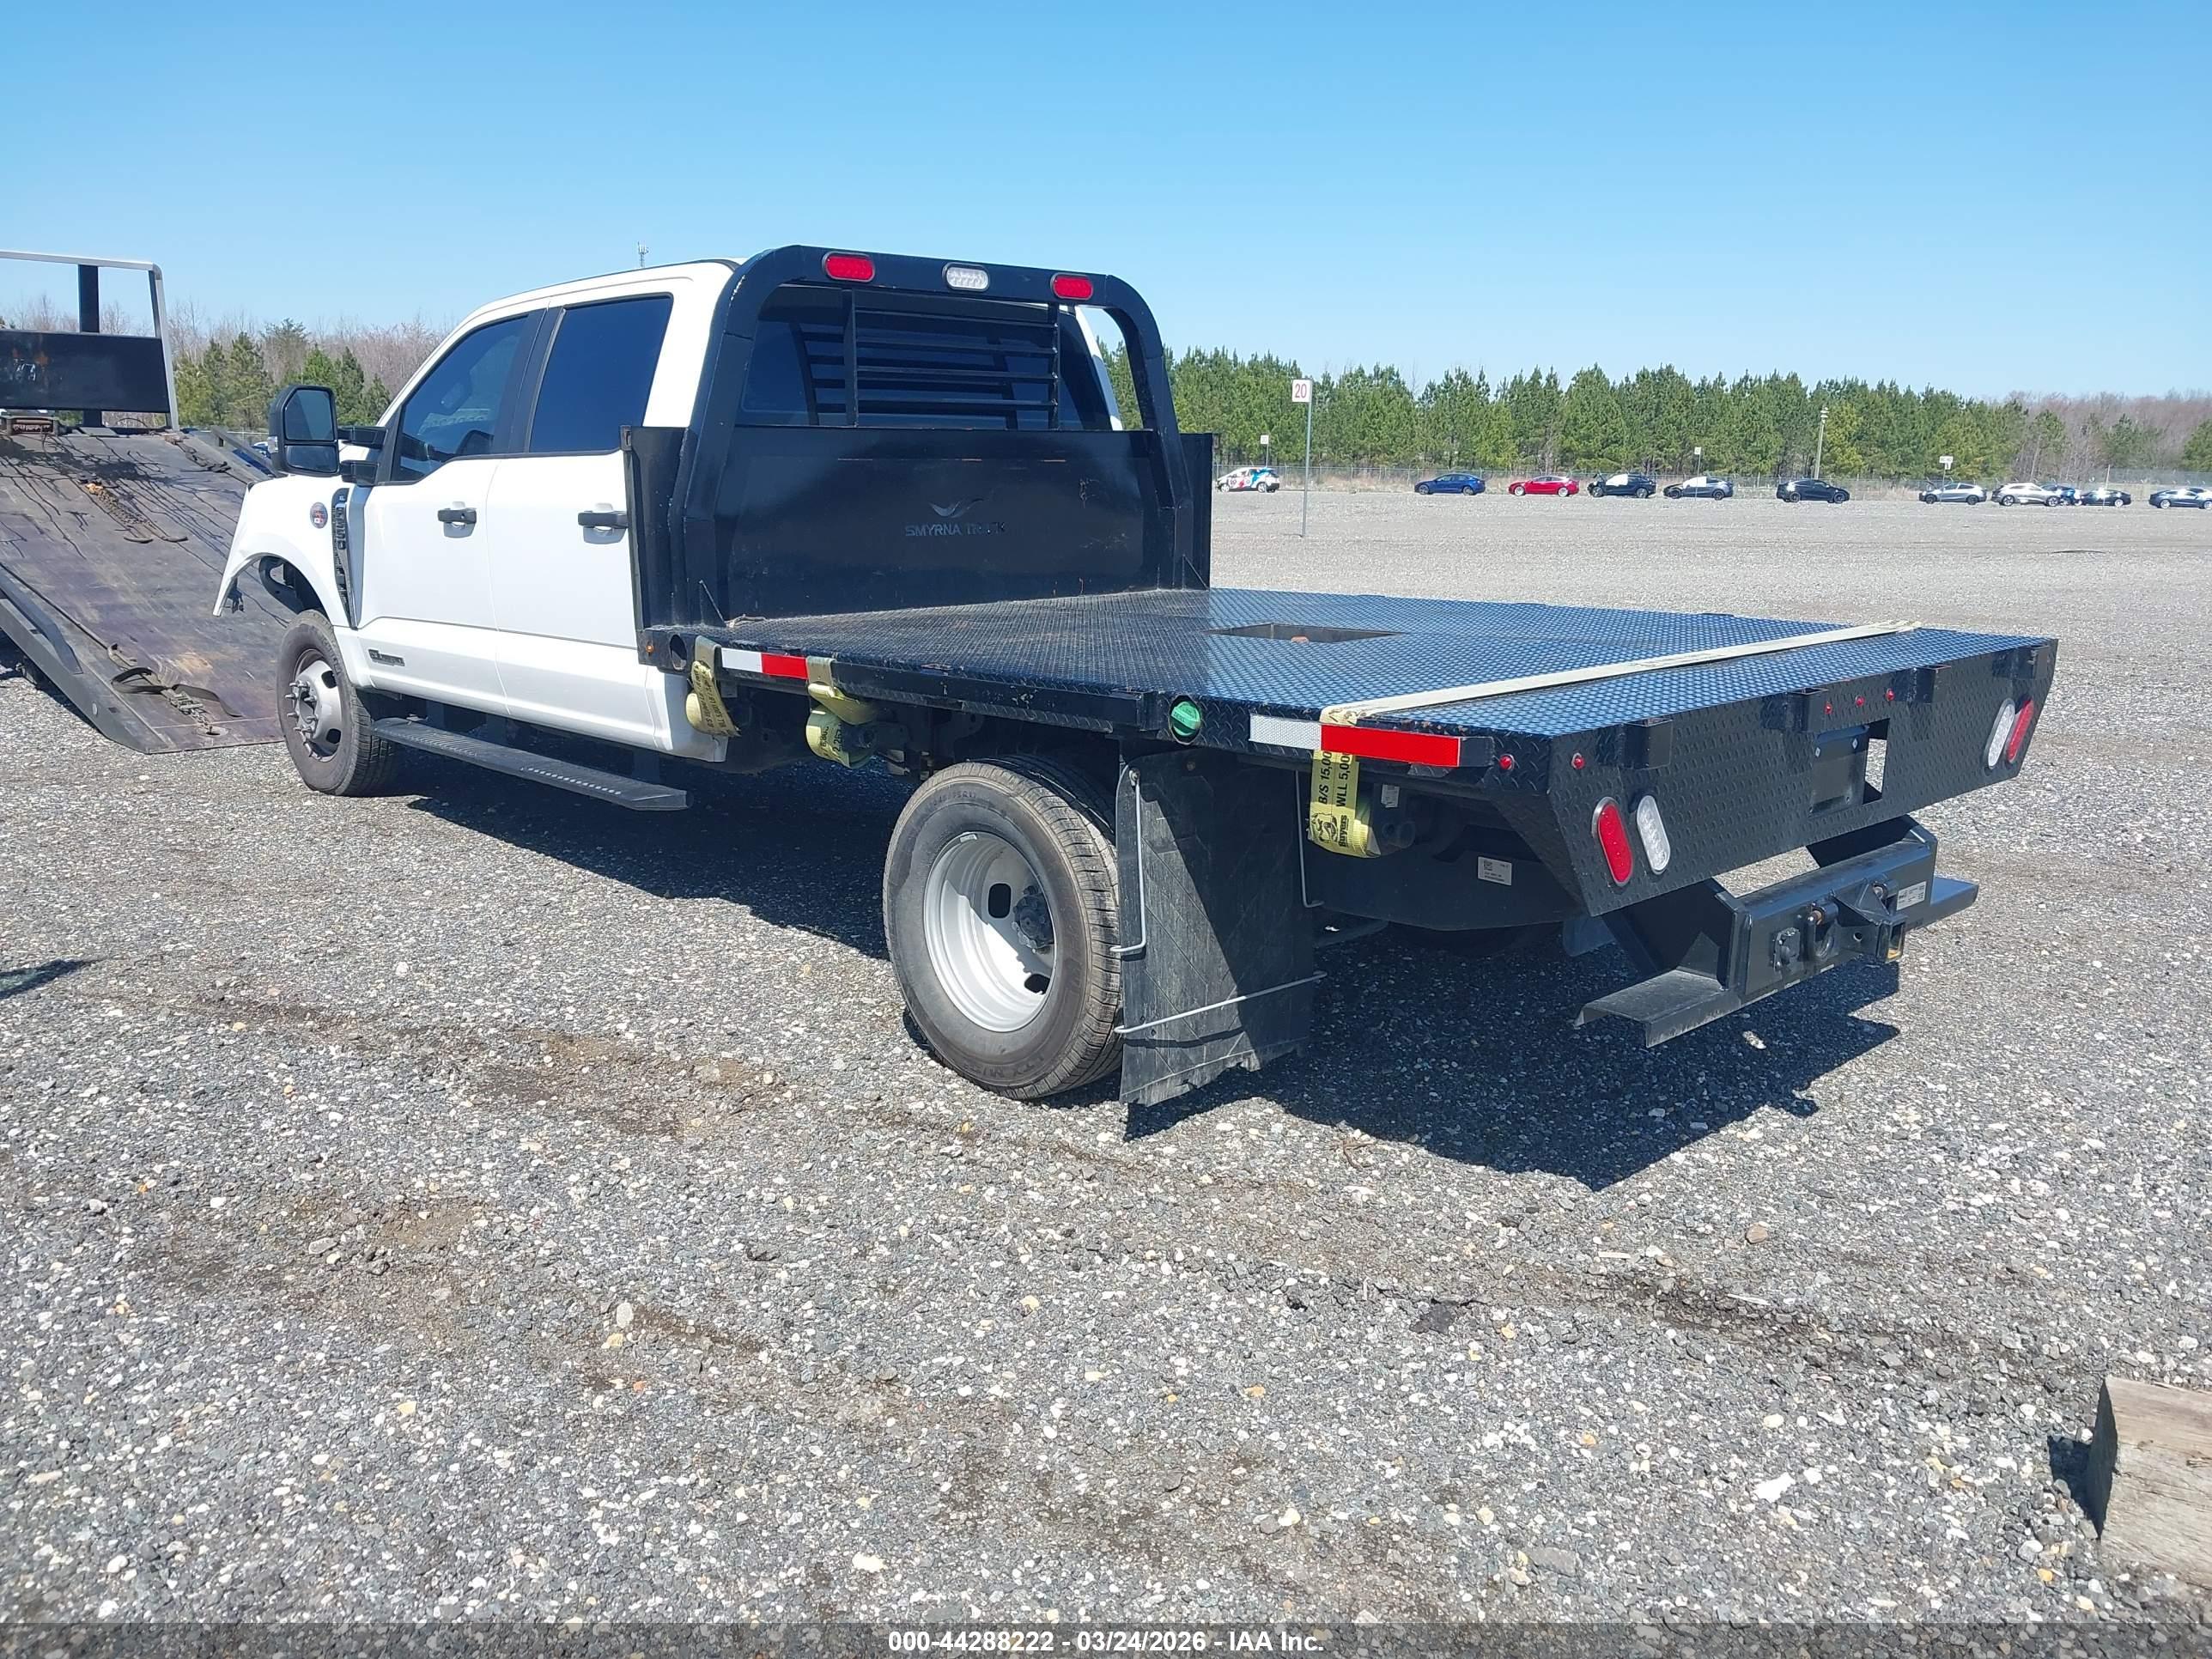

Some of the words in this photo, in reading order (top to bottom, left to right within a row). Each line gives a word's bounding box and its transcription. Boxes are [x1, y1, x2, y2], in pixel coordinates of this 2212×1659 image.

[1295, 383, 1308, 398] 20
[905, 523, 962, 537] SMYRNA
[1339, 752, 1351, 781] 5,00
[1318, 784, 1329, 805] B/S
[1336, 783, 1348, 807] WLL
[1337, 814, 1349, 848] Buyers
